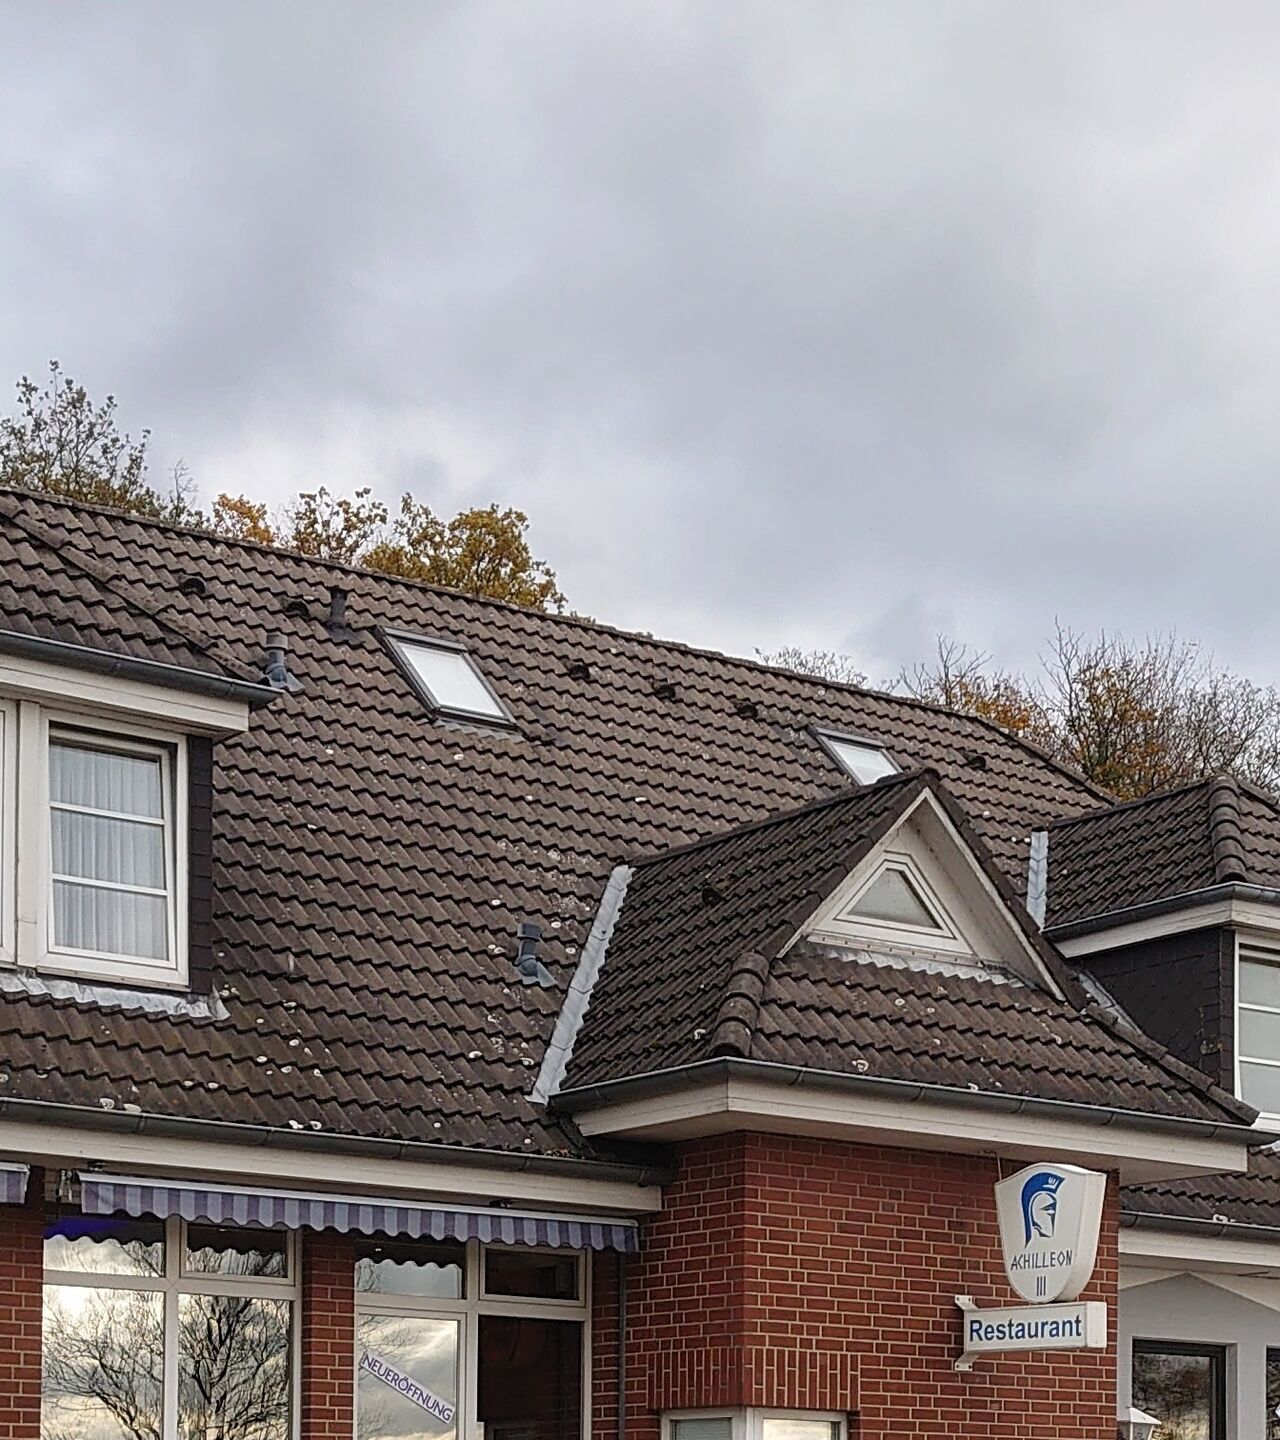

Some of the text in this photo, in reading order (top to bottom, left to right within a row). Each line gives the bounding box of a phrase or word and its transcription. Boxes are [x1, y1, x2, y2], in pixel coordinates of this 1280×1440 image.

[1010, 1250, 1072, 1271] ACHILLEON
[1036, 1275, 1047, 1296] III
[970, 1314, 1082, 1342] Restaurant
[362, 1353, 453, 1422] NEUERÖFFNUNG
